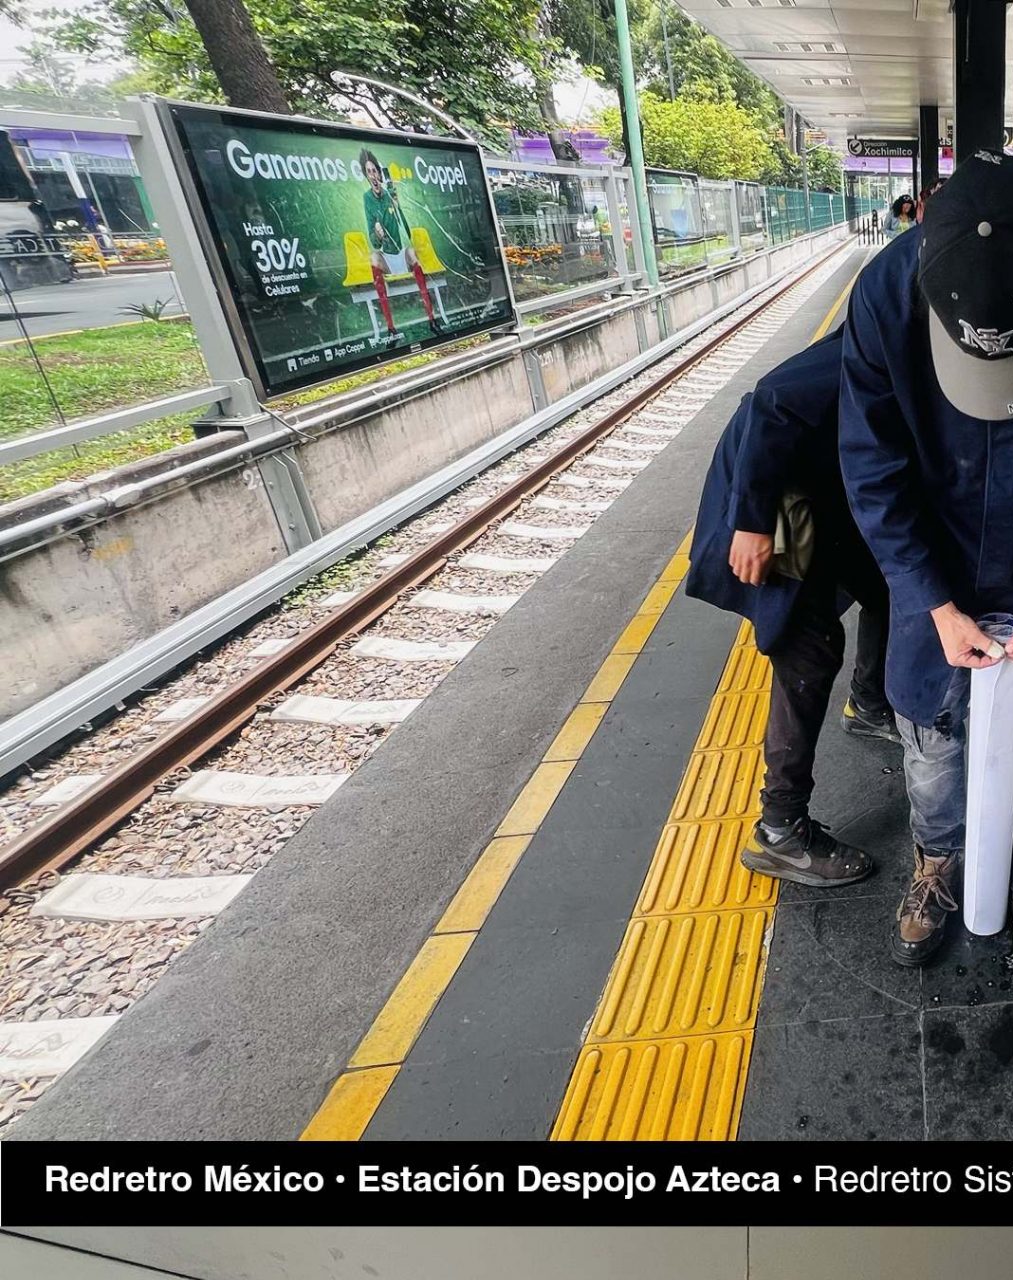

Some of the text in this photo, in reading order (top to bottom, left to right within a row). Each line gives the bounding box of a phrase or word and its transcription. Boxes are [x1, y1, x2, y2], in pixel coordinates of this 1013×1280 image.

[864, 147, 913, 156] Xochimilco
[226, 139, 348, 182] Ganamos
[414, 155, 468, 193] Coppel
[242, 222, 274, 237] Hasta
[251, 237, 306, 273] 30%
[261, 271, 308, 284] de descuento en
[265, 284, 300, 297] Celulares
[334, 341, 366, 357] App Coppel
[298, 354, 320, 366] Tienda
